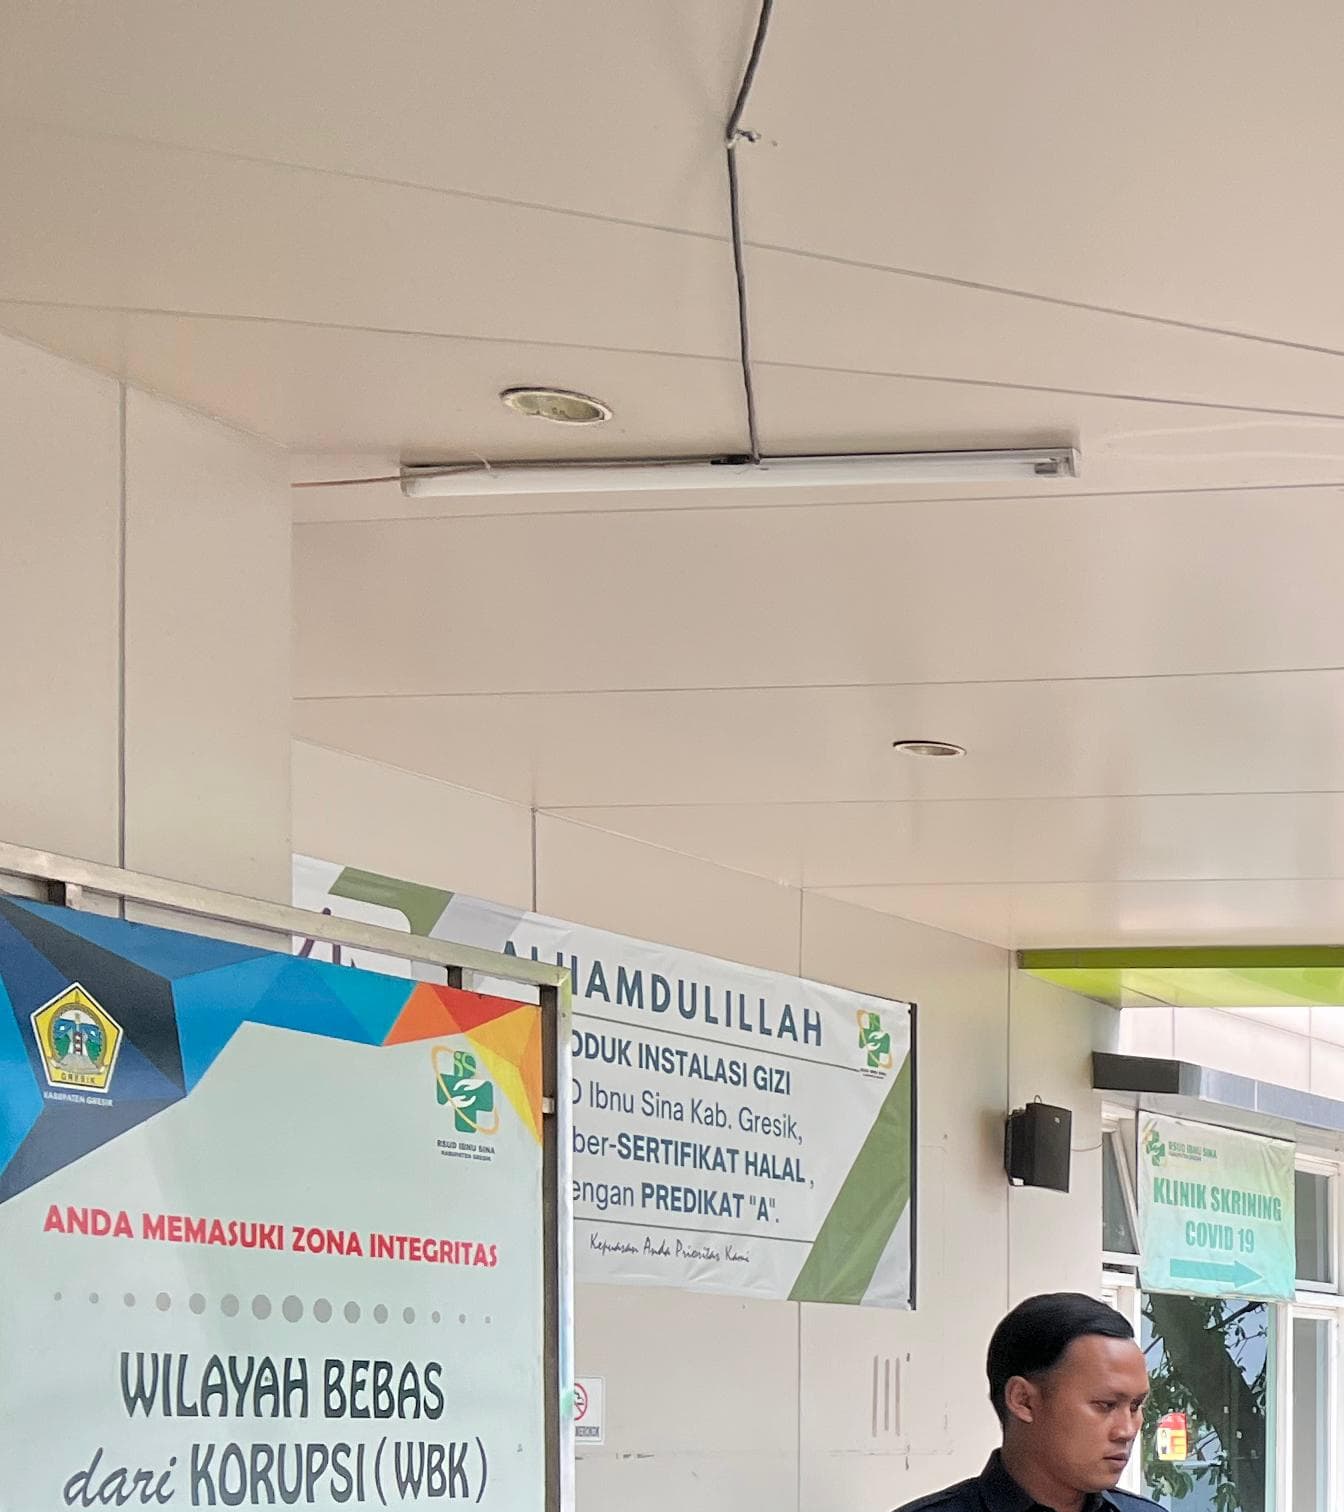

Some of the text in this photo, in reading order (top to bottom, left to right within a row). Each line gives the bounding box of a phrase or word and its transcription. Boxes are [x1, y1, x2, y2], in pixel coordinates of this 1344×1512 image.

[572, 1029, 791, 1095] ODUK INSTALASI GIZI
[589, 1080, 634, 1113] Ibnu
[641, 1090, 684, 1122] Sina
[691, 1098, 732, 1129] Kab.
[738, 1107, 802, 1145] Gresik,
[572, 1180, 634, 1210] engan
[641, 1182, 744, 1218] PREDIKAT
[1153, 1176, 1282, 1221] KLINIK SKRINING
[43, 1204, 498, 1268] ANDA MEMASUKI ZONA INTEGRITAS
[1185, 1220, 1255, 1253] COVID 19
[120, 1351, 445, 1420] WILAYAH BEBAS
[64, 1436, 487, 1507] dari KORUPSI (WBK)
